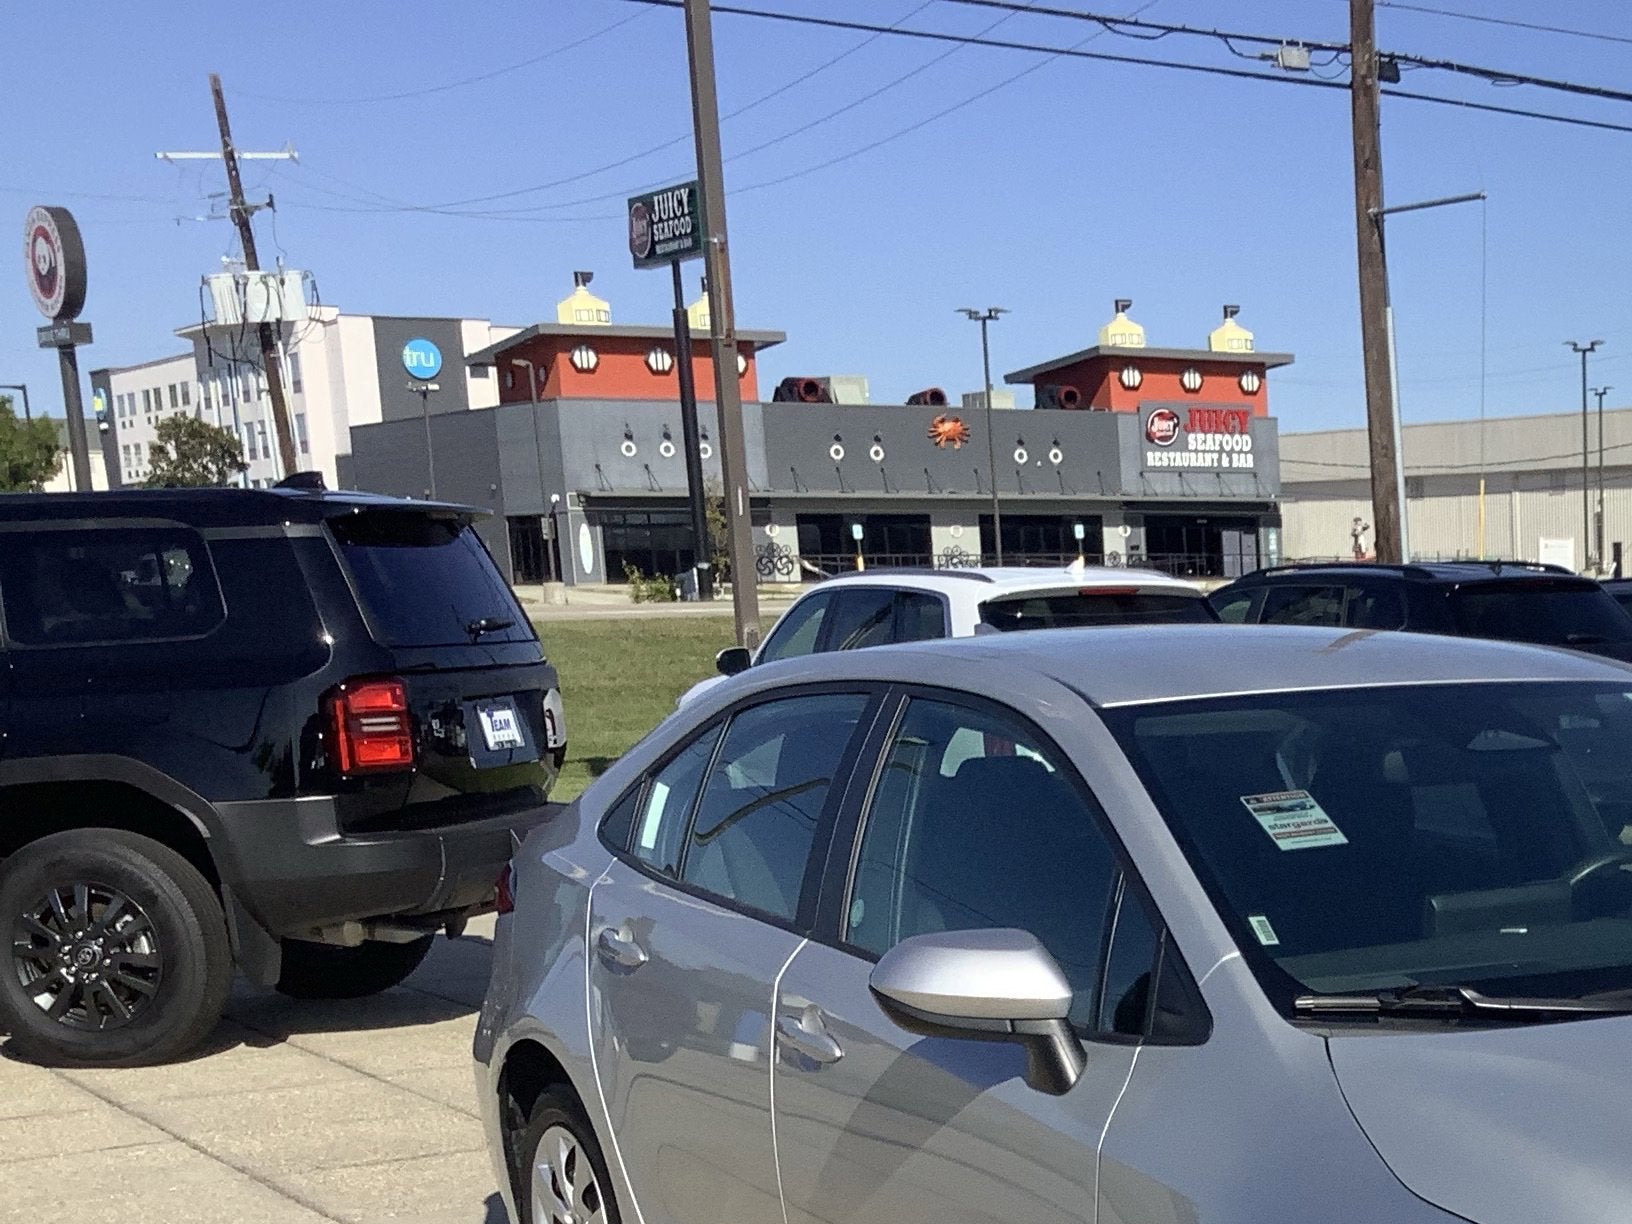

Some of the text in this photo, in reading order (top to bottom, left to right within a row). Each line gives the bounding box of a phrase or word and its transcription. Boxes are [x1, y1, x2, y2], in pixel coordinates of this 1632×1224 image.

[651, 188, 689, 222] JUICY
[653, 216, 692, 241] SEAFOOD
[403, 345, 435, 367] tru
[1183, 408, 1249, 434] JUICY
[1187, 433, 1253, 452] SEAFOOD
[1146, 451, 1255, 468] RESTAURANT & BAR
